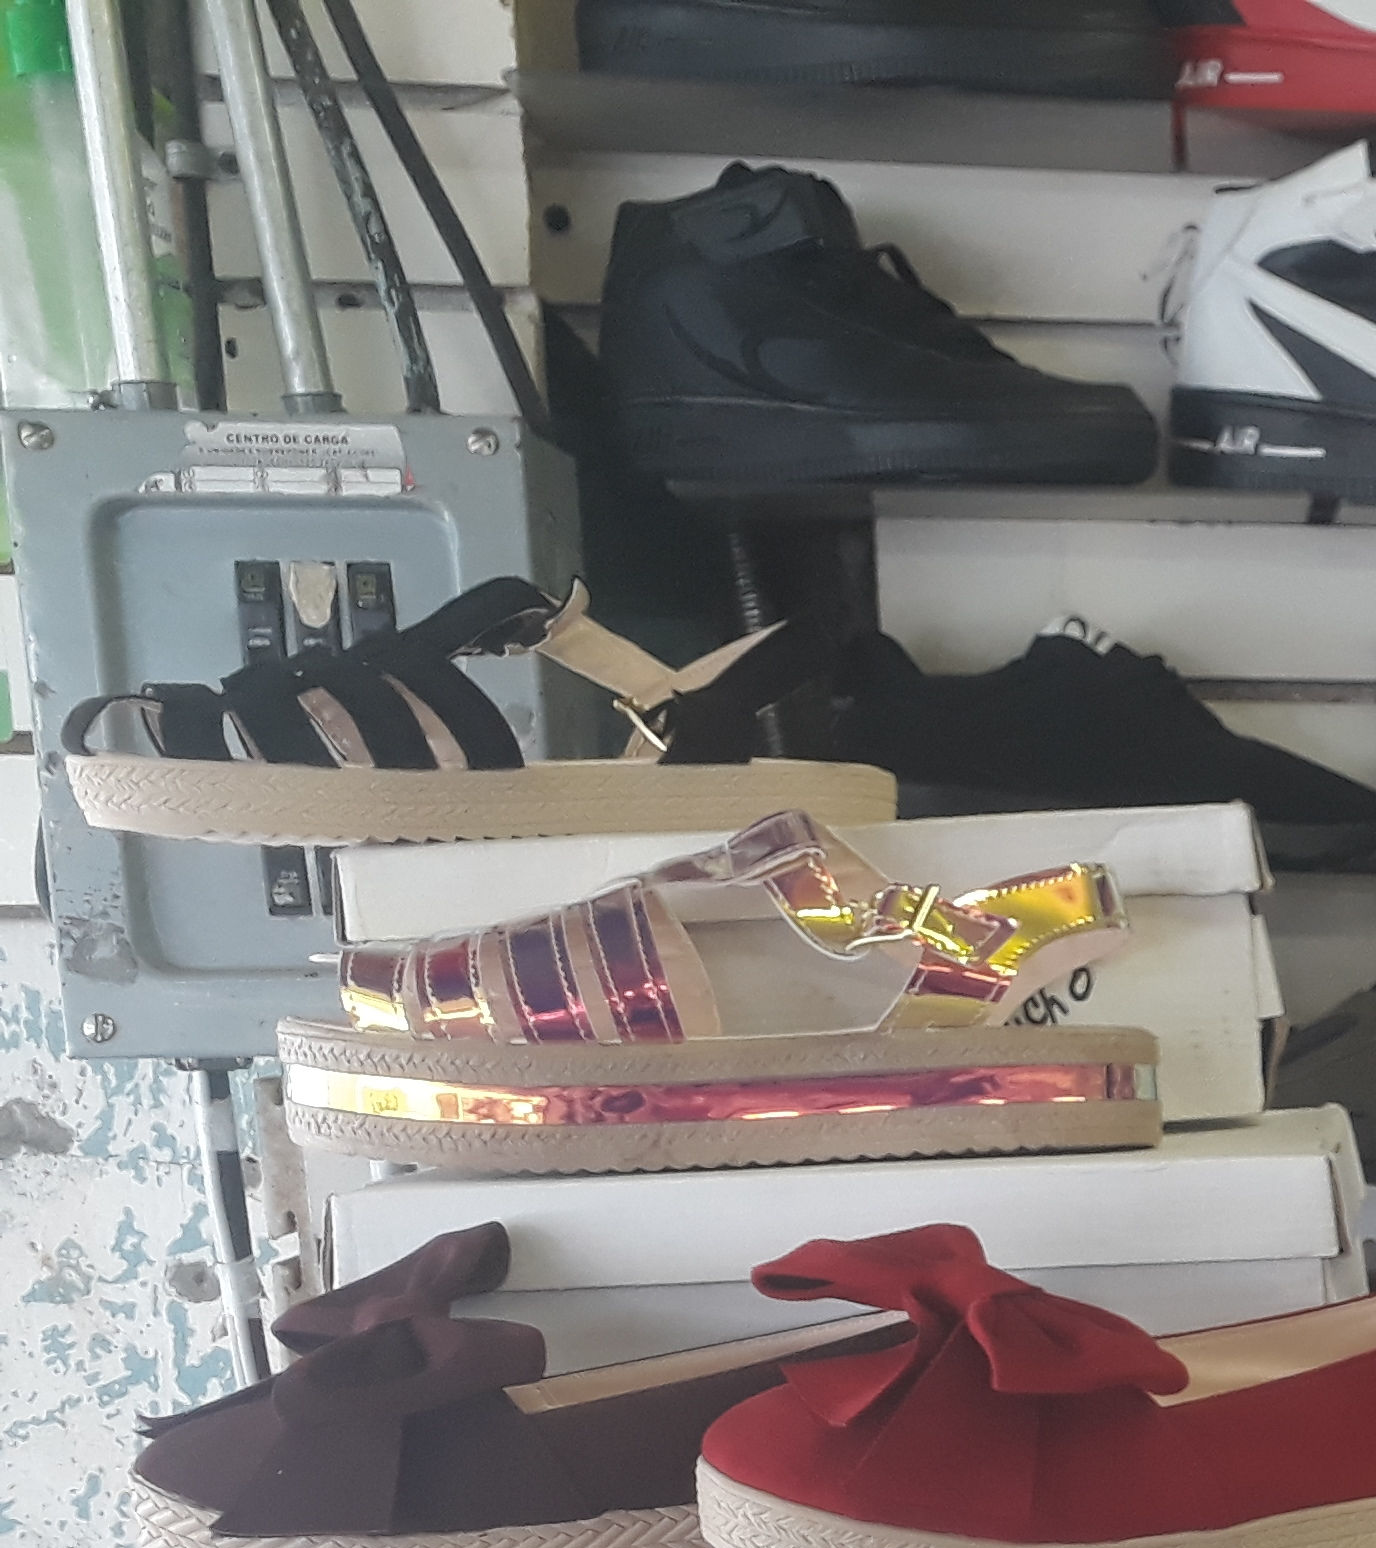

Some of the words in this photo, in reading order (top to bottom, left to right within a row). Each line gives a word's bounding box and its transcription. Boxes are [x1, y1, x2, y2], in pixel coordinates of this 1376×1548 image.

[226, 433, 279, 446] CENTRO
[283, 433, 298, 445] DE
[303, 432, 349, 446] CARGA
